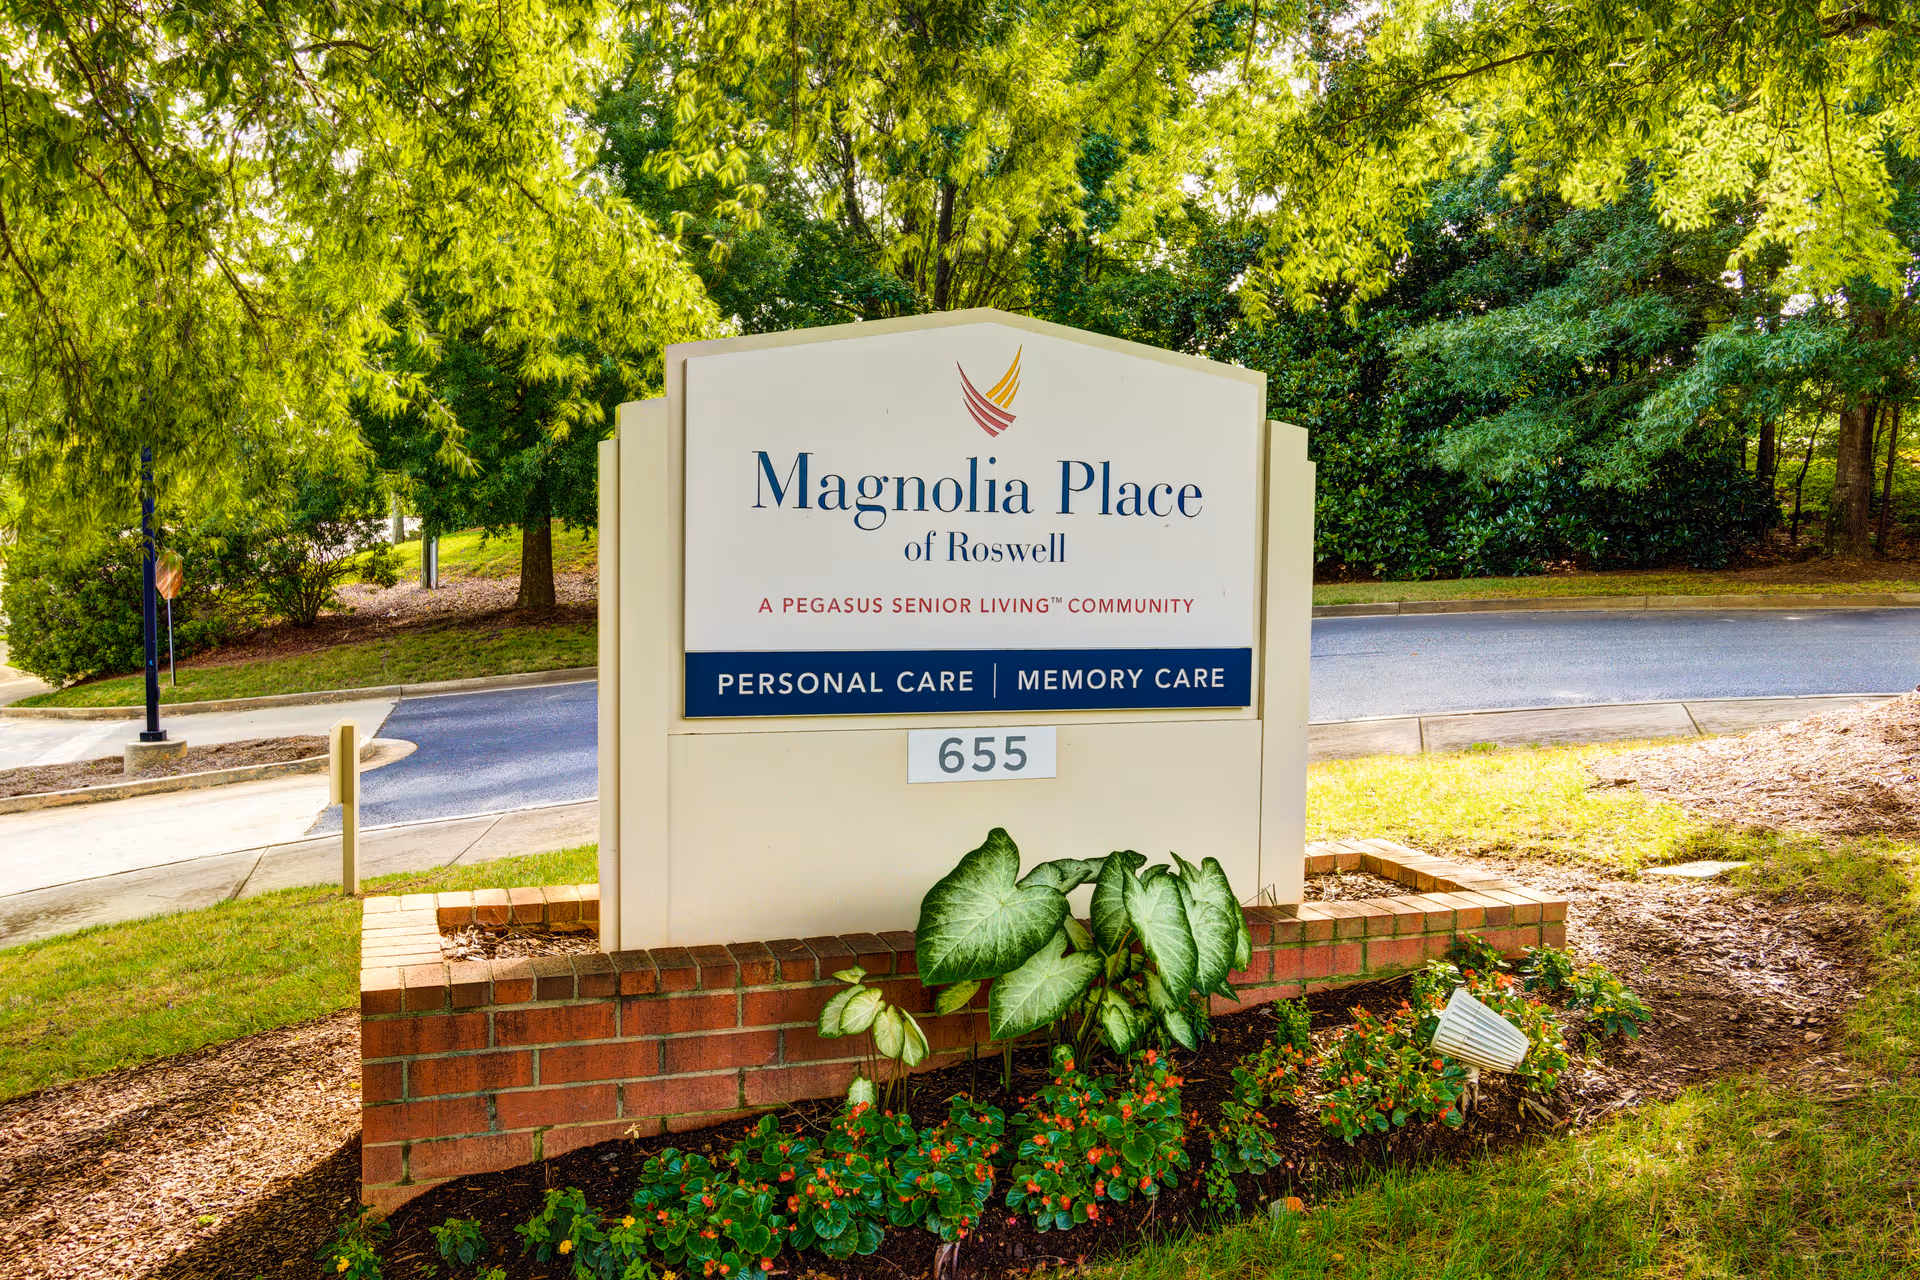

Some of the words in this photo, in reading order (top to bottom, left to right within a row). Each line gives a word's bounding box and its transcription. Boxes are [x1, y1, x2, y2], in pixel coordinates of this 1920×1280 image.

[751, 450, 1035, 531] Magnolia
[1056, 459, 1204, 519] Place
[904, 530, 938, 563] of
[946, 531, 1067, 564] Roswell
[758, 597, 773, 614] A
[783, 597, 883, 614] PEGASUS
[892, 597, 972, 614] SENIOR
[1068, 597, 1195, 614] COMMUNITY
[717, 671, 884, 696] PERSONAL
[896, 670, 974, 693] CARE
[1017, 668, 1144, 691] MEMORY
[1154, 667, 1225, 689] CARE
[937, 735, 1029, 774] 655
